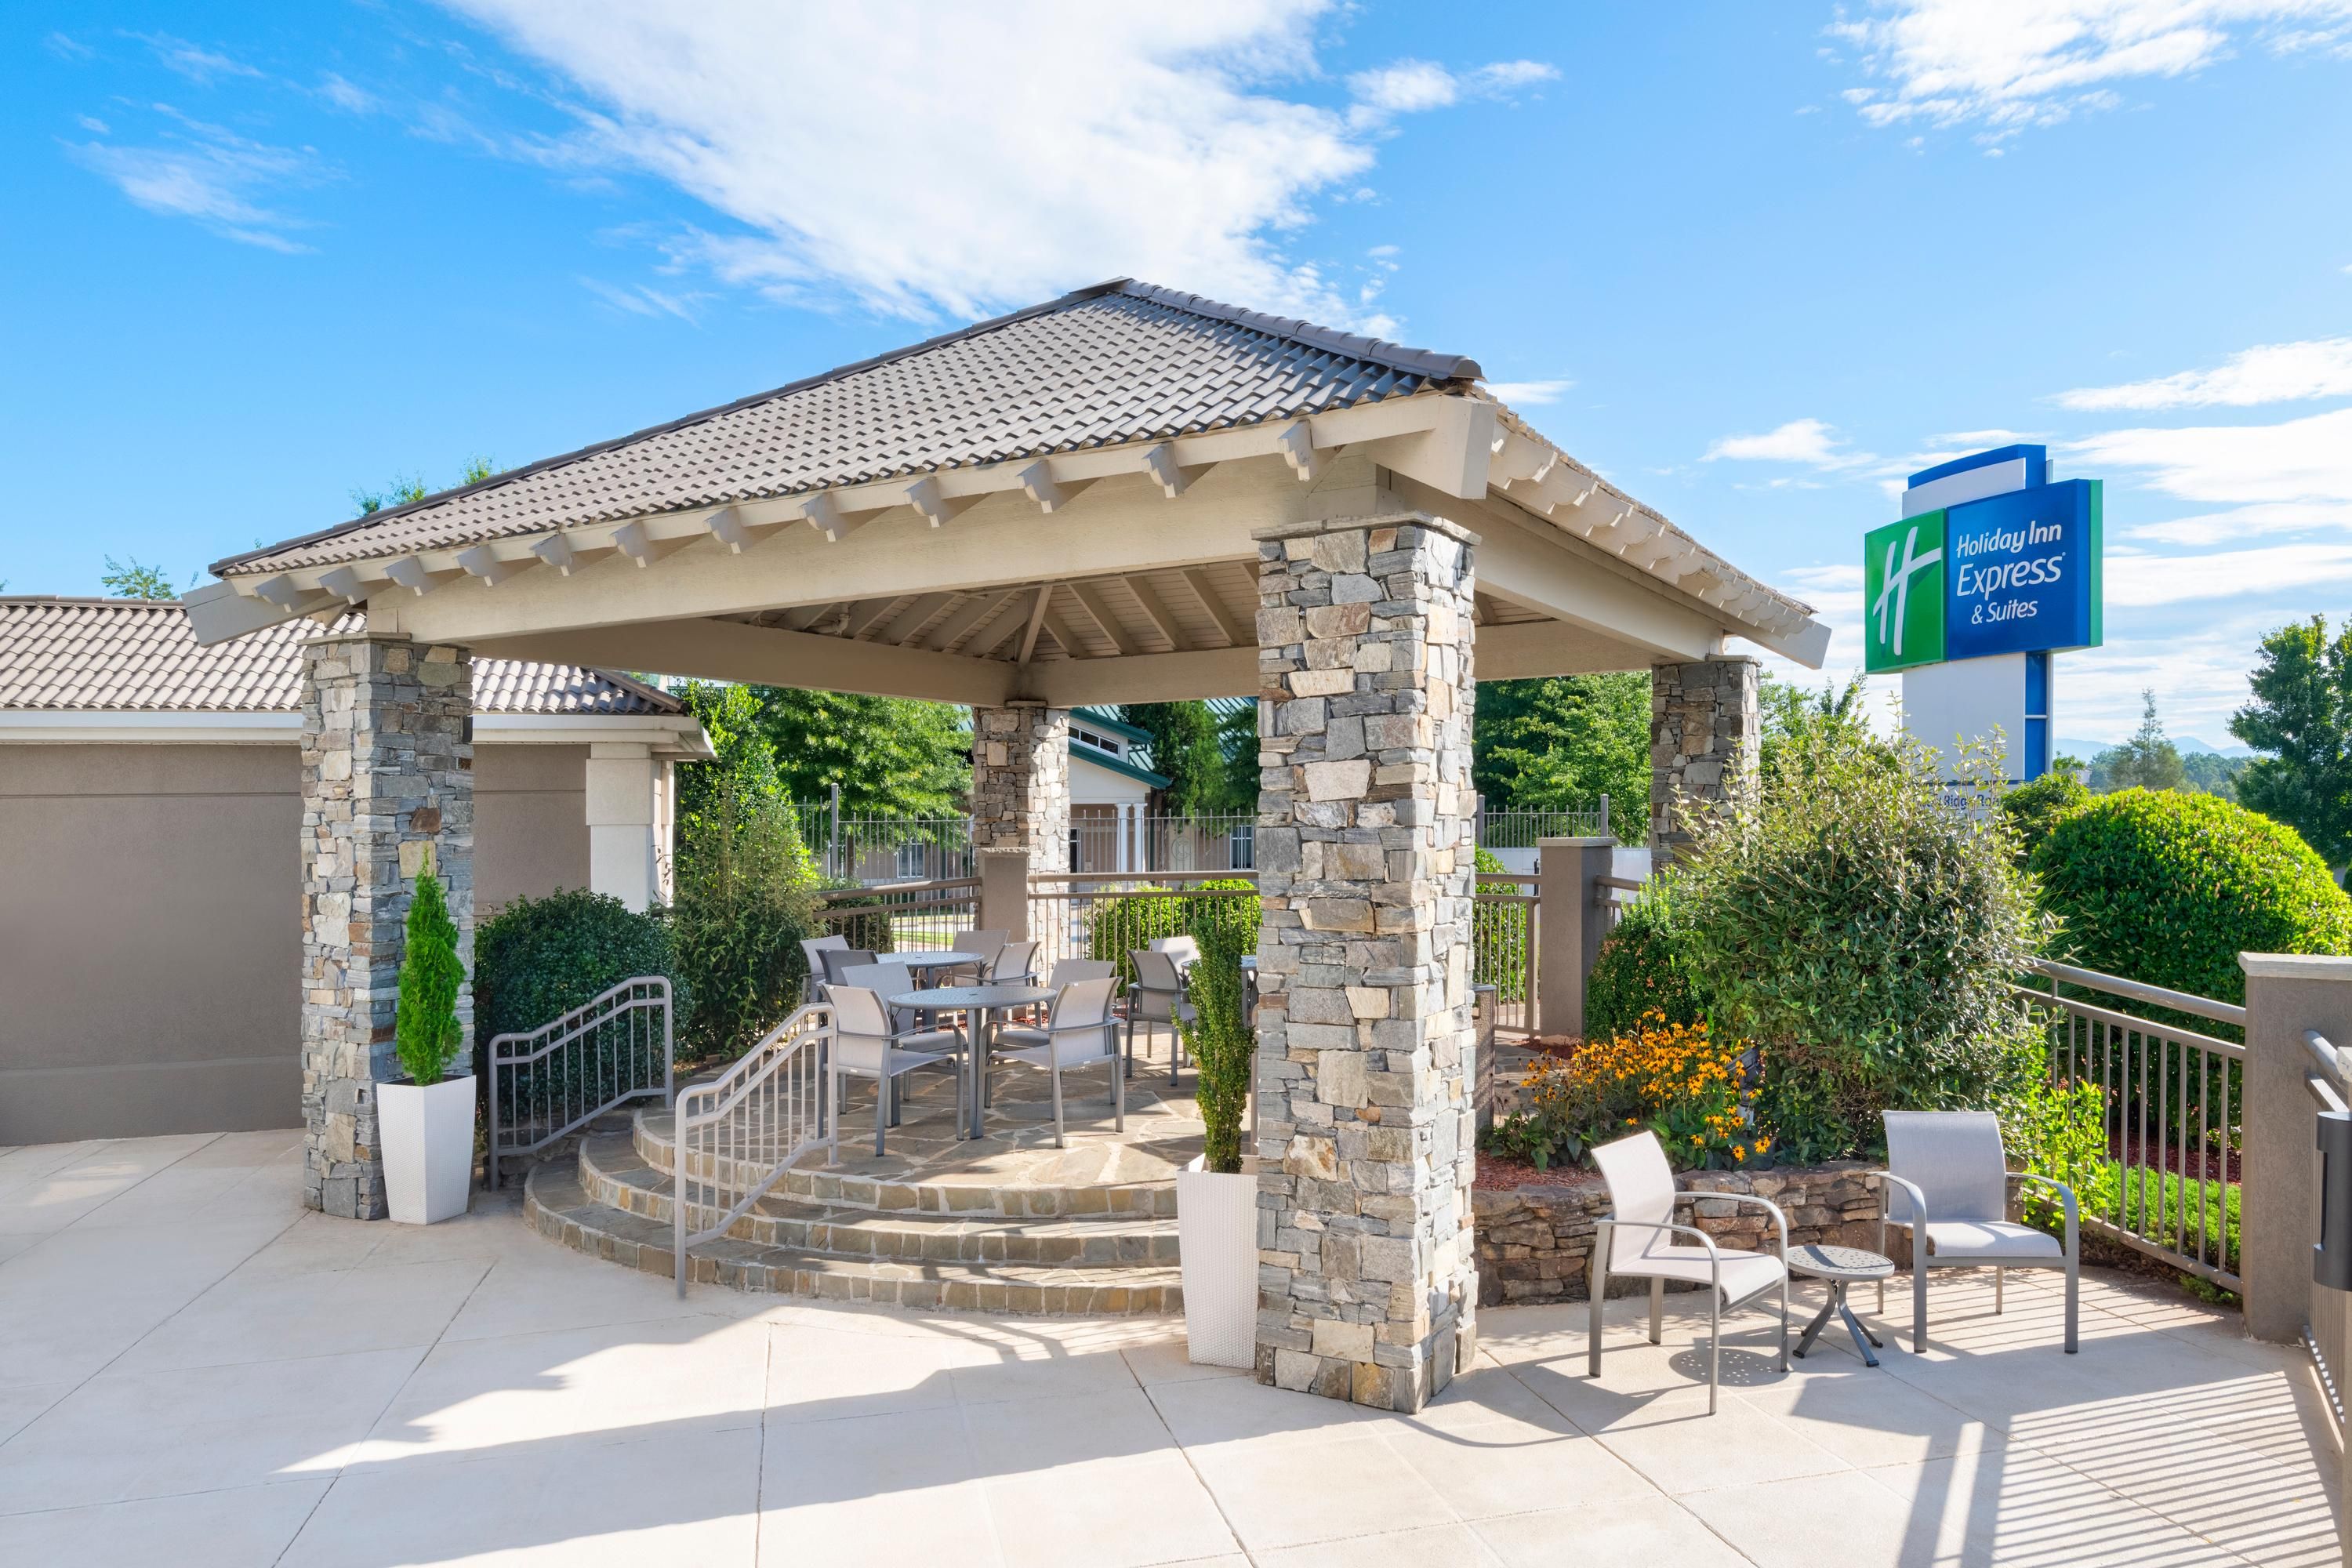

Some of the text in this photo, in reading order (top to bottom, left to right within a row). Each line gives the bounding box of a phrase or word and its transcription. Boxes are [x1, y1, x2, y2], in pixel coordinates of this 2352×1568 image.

[1955, 520, 2063, 559] Holiday Inn
[1956, 555, 2063, 601] Express
[1971, 598, 2039, 625] & Suites
[1944, 794, 1973, 810] Ridg
